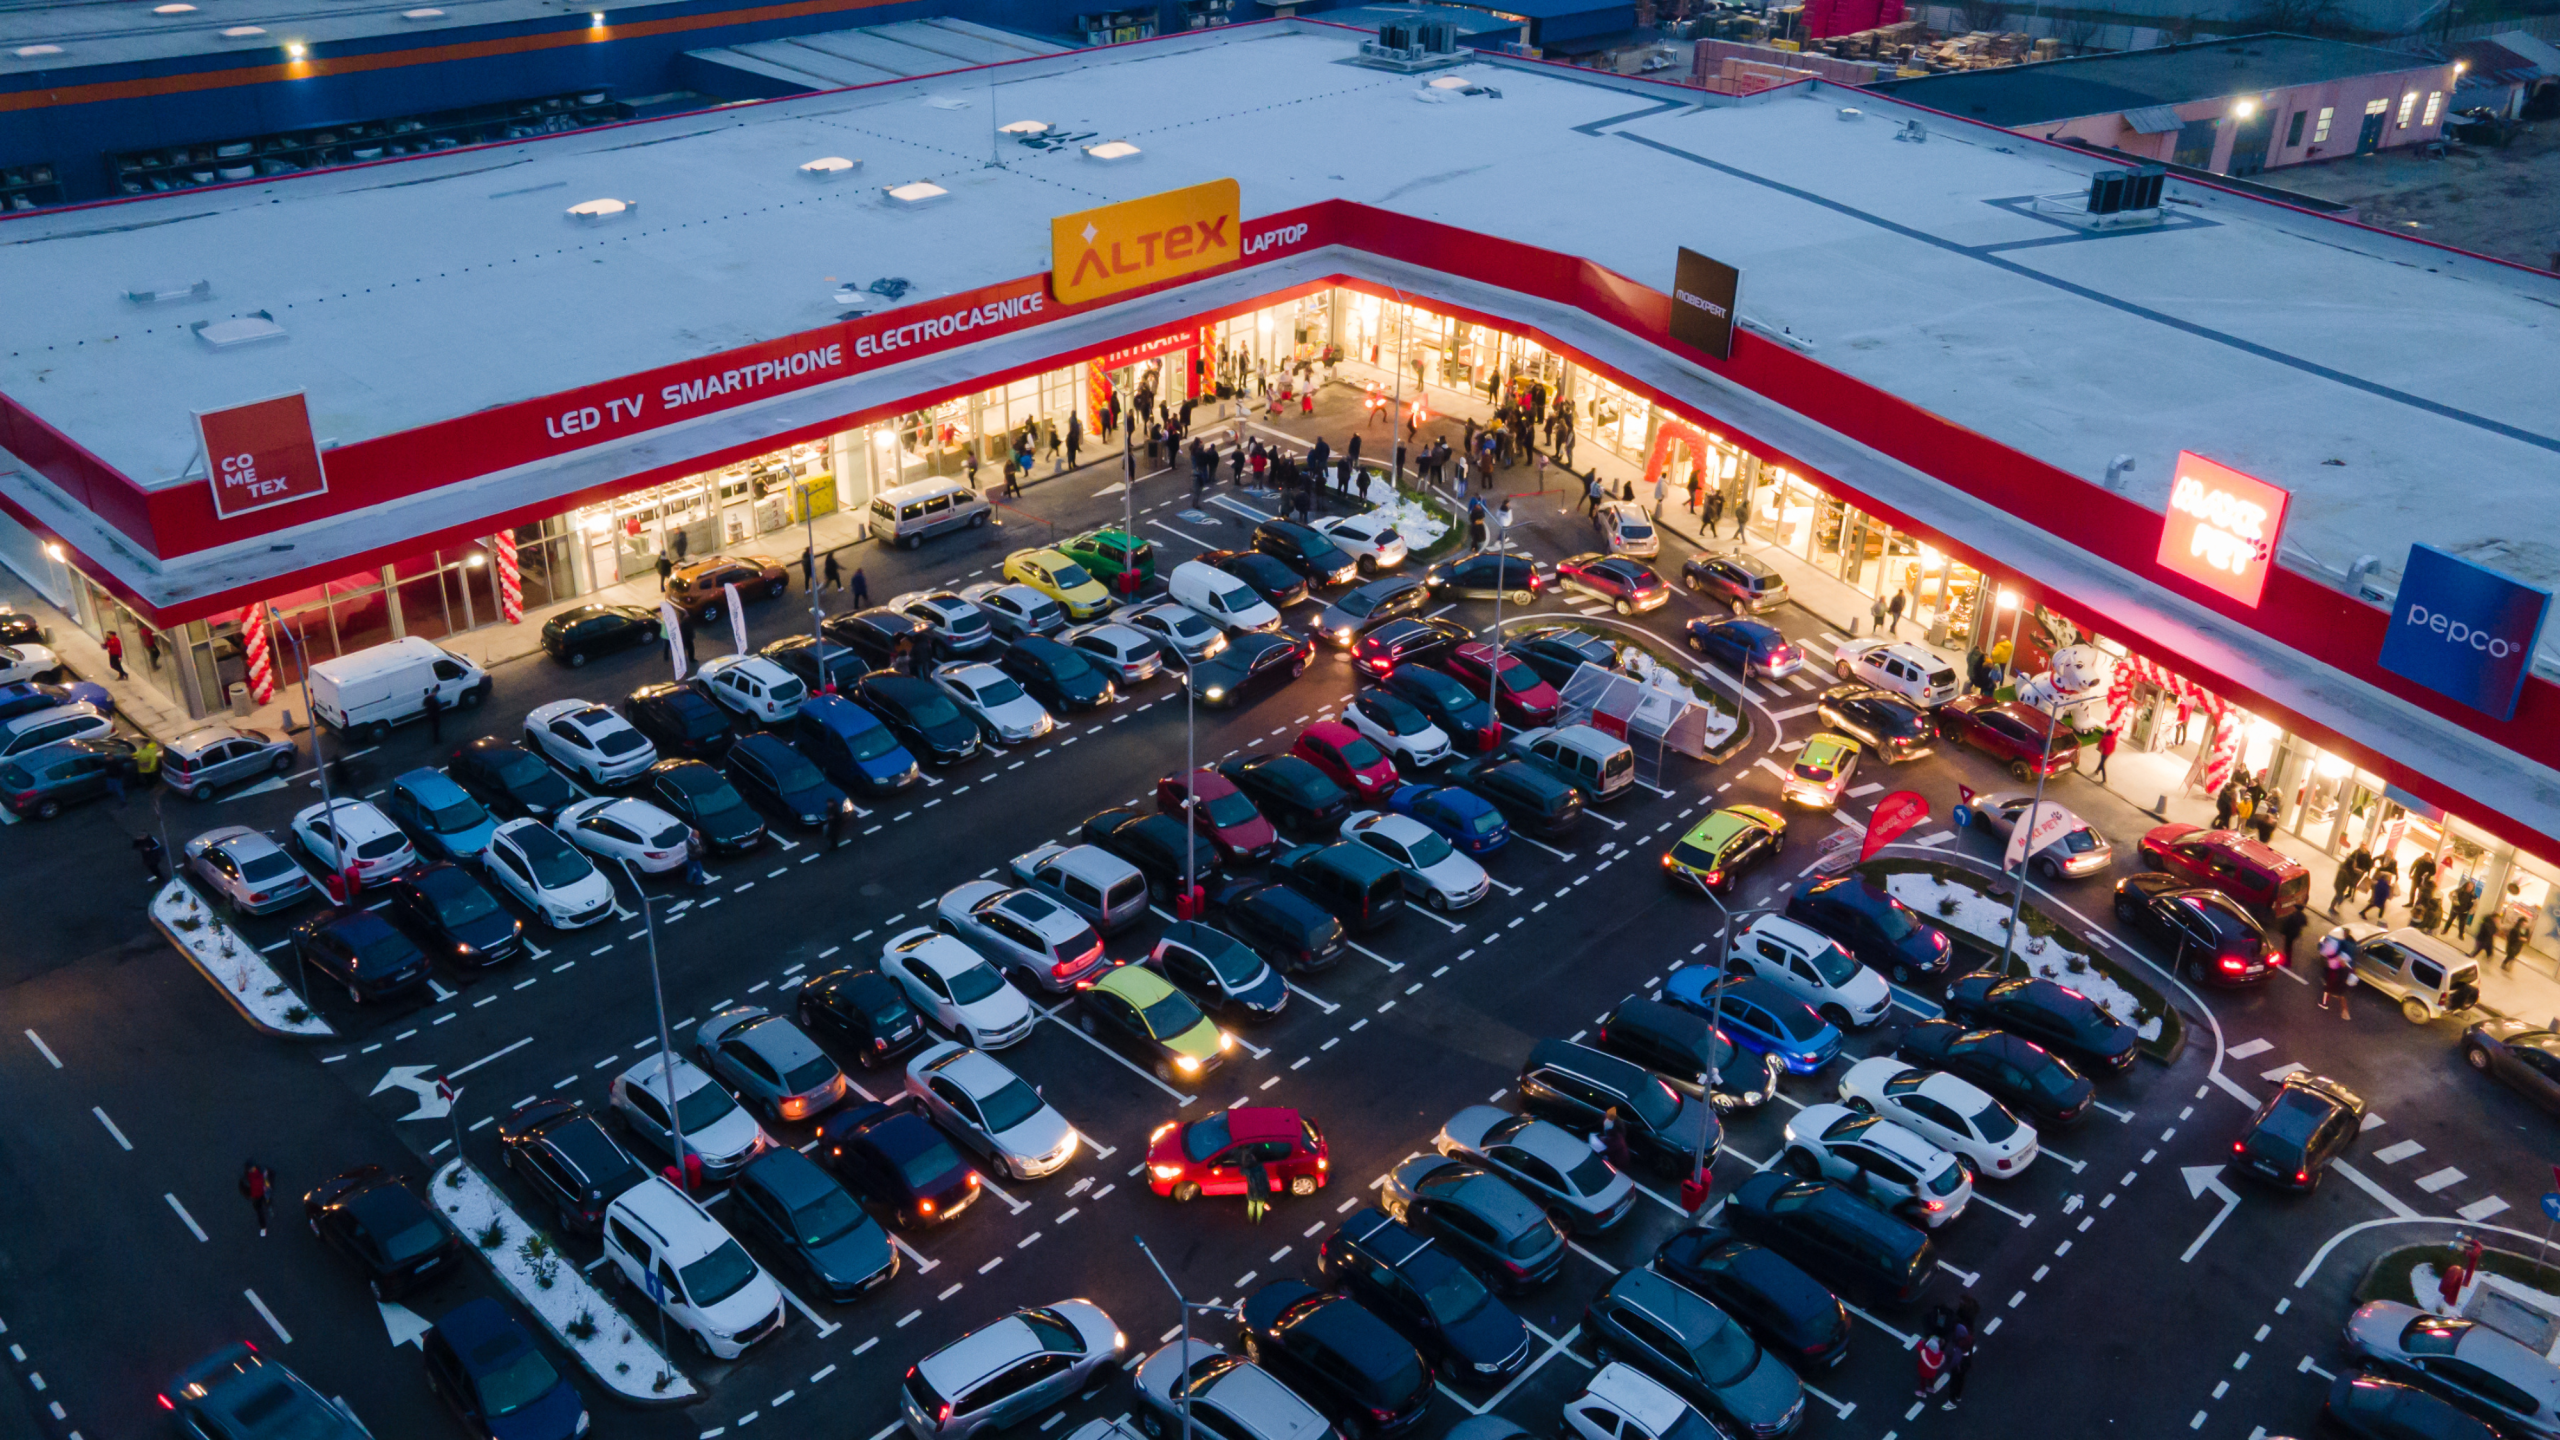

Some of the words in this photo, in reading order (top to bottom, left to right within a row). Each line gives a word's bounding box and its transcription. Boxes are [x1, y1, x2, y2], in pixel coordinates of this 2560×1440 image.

[1243, 223, 1309, 255] LAPTOP
[1676, 289, 1727, 319] MOBEXPERT
[545, 405, 601, 439] LED
[605, 394, 644, 422] TV
[661, 343, 842, 409] SMARTPHONE
[855, 291, 1043, 358] ELECTROCASNICE
[221, 453, 254, 472] CO
[224, 467, 257, 488] ME
[247, 476, 288, 498] TEX
[2190, 522, 2258, 576] PET
[2041, 816, 2060, 833] PET
